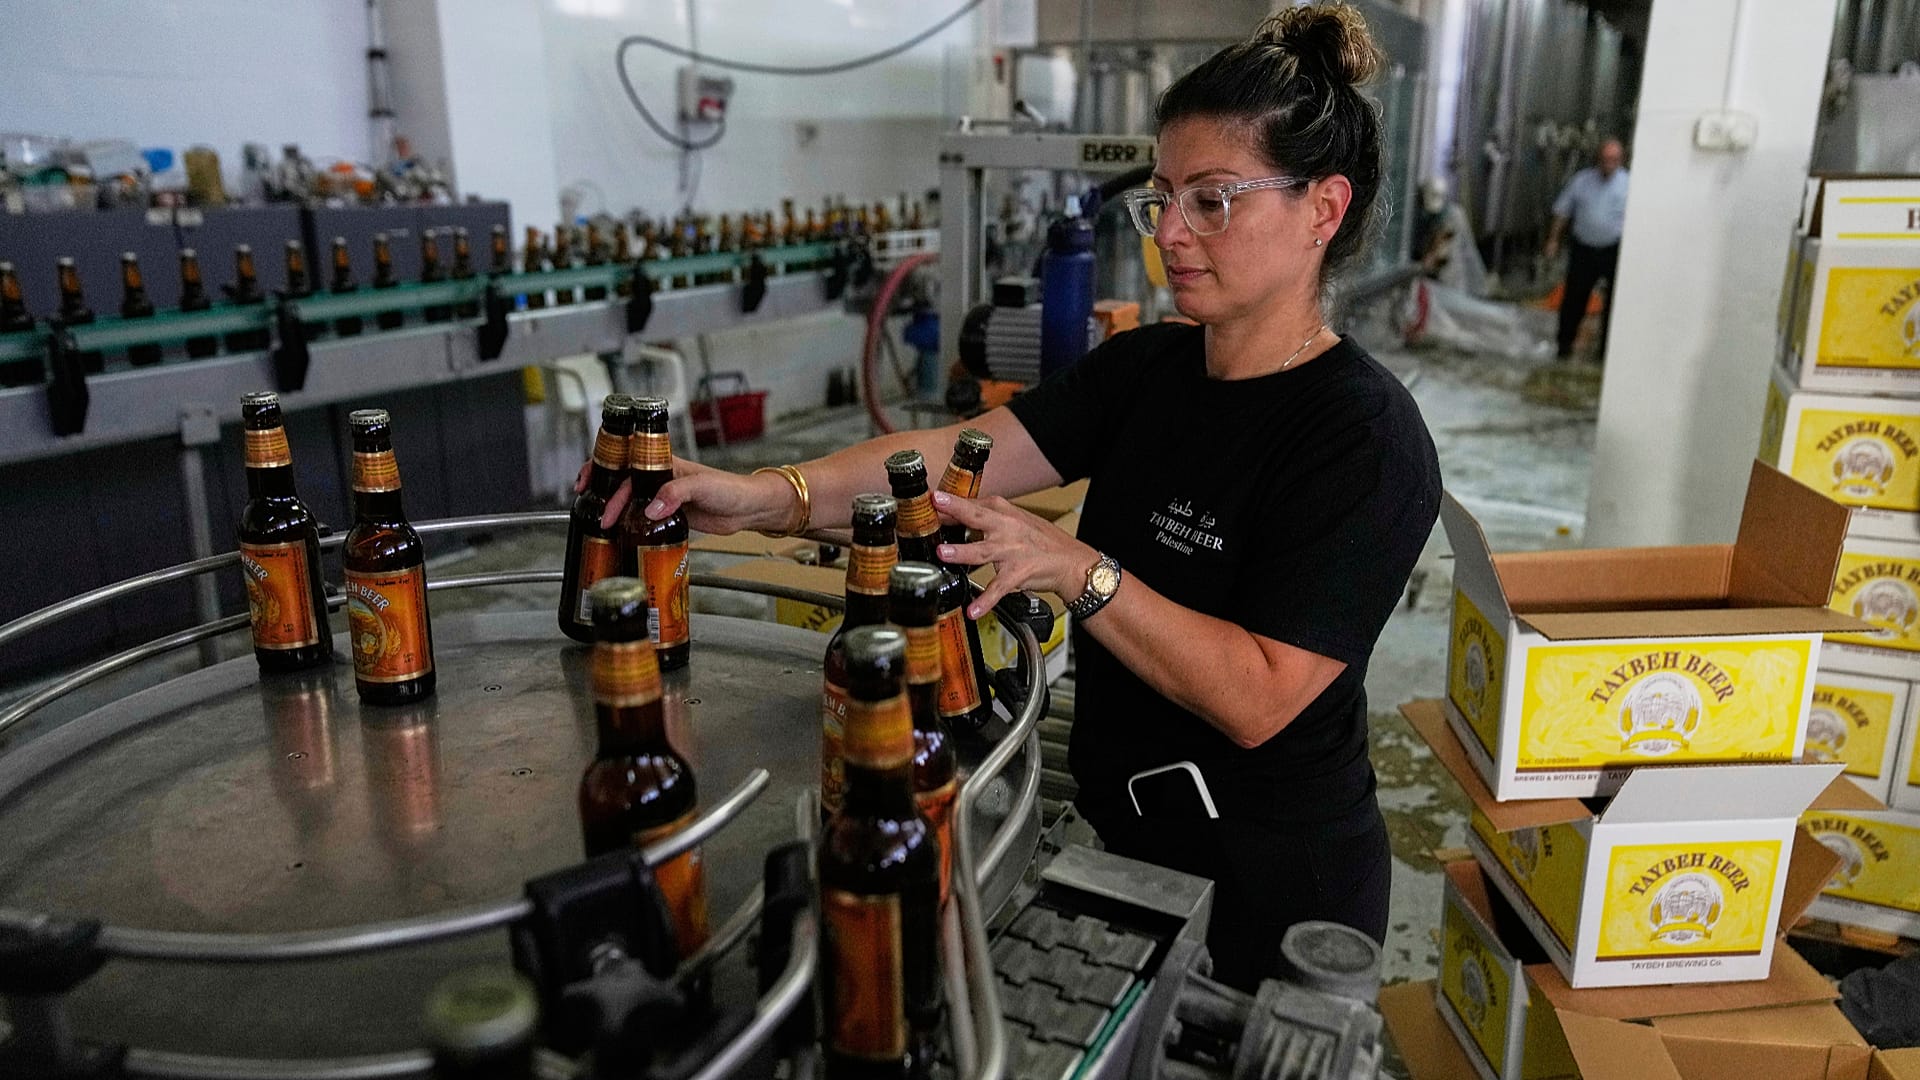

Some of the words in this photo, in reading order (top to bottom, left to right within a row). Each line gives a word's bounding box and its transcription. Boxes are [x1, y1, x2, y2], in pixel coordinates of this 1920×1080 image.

[1817, 420, 1881, 453] TAYBEH
[1882, 423, 1919, 459] BEER
[1149, 511, 1192, 539] TAYBEH
[1190, 529, 1223, 551] BEER
[1155, 530, 1194, 556] Palestine
[1835, 563, 1904, 596] TAYBEH
[360, 585, 390, 612] BEER
[1590, 651, 1681, 705] TAYBEH
[1684, 653, 1735, 703] BEER
[1836, 694, 1870, 729] BEER
[1850, 826, 1889, 863] BEER
[1630, 853, 1707, 897] TAYBEH
[1707, 854, 1750, 893] BEER
[1631, 962, 1664, 970] TAYBEH
[1666, 960, 1708, 969] BREWING
